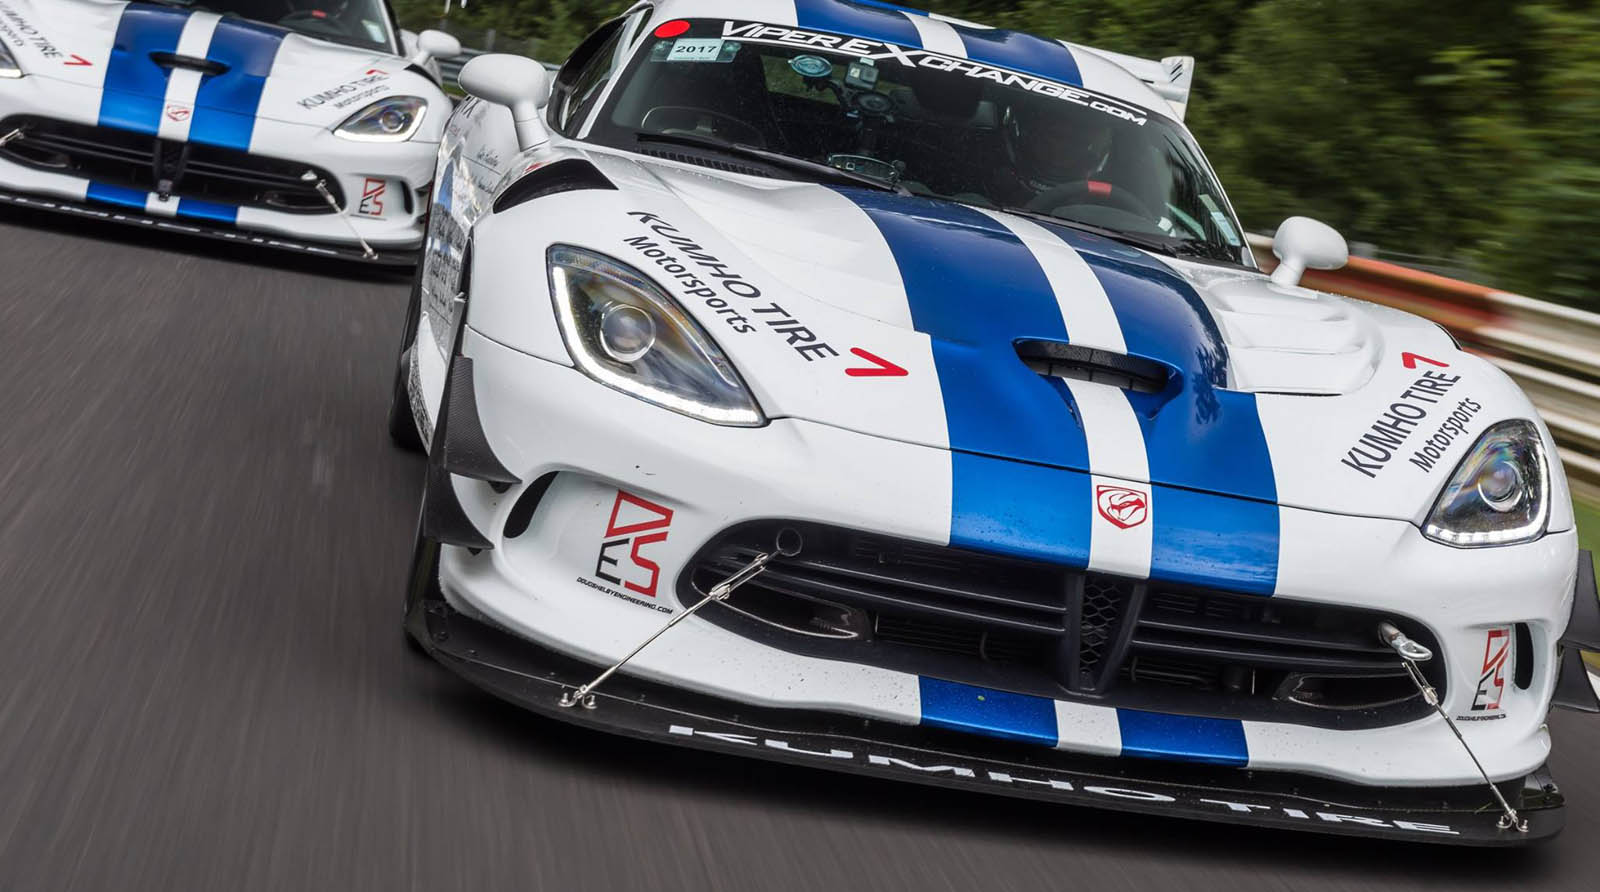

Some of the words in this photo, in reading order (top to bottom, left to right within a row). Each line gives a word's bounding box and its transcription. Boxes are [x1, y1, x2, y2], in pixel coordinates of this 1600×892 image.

[674, 45, 717, 54] 2017
[623, 236, 757, 334] Motorsports
[626, 211, 762, 299] KUMHO
[751, 302, 840, 362] TIRE
[1340, 402, 1427, 478] KUMHO
[1400, 370, 1461, 403] TIRE
[1408, 397, 1482, 473] Motorsports
[668, 724, 1177, 802] KUMHO
[1200, 798, 1460, 835] TIRE
